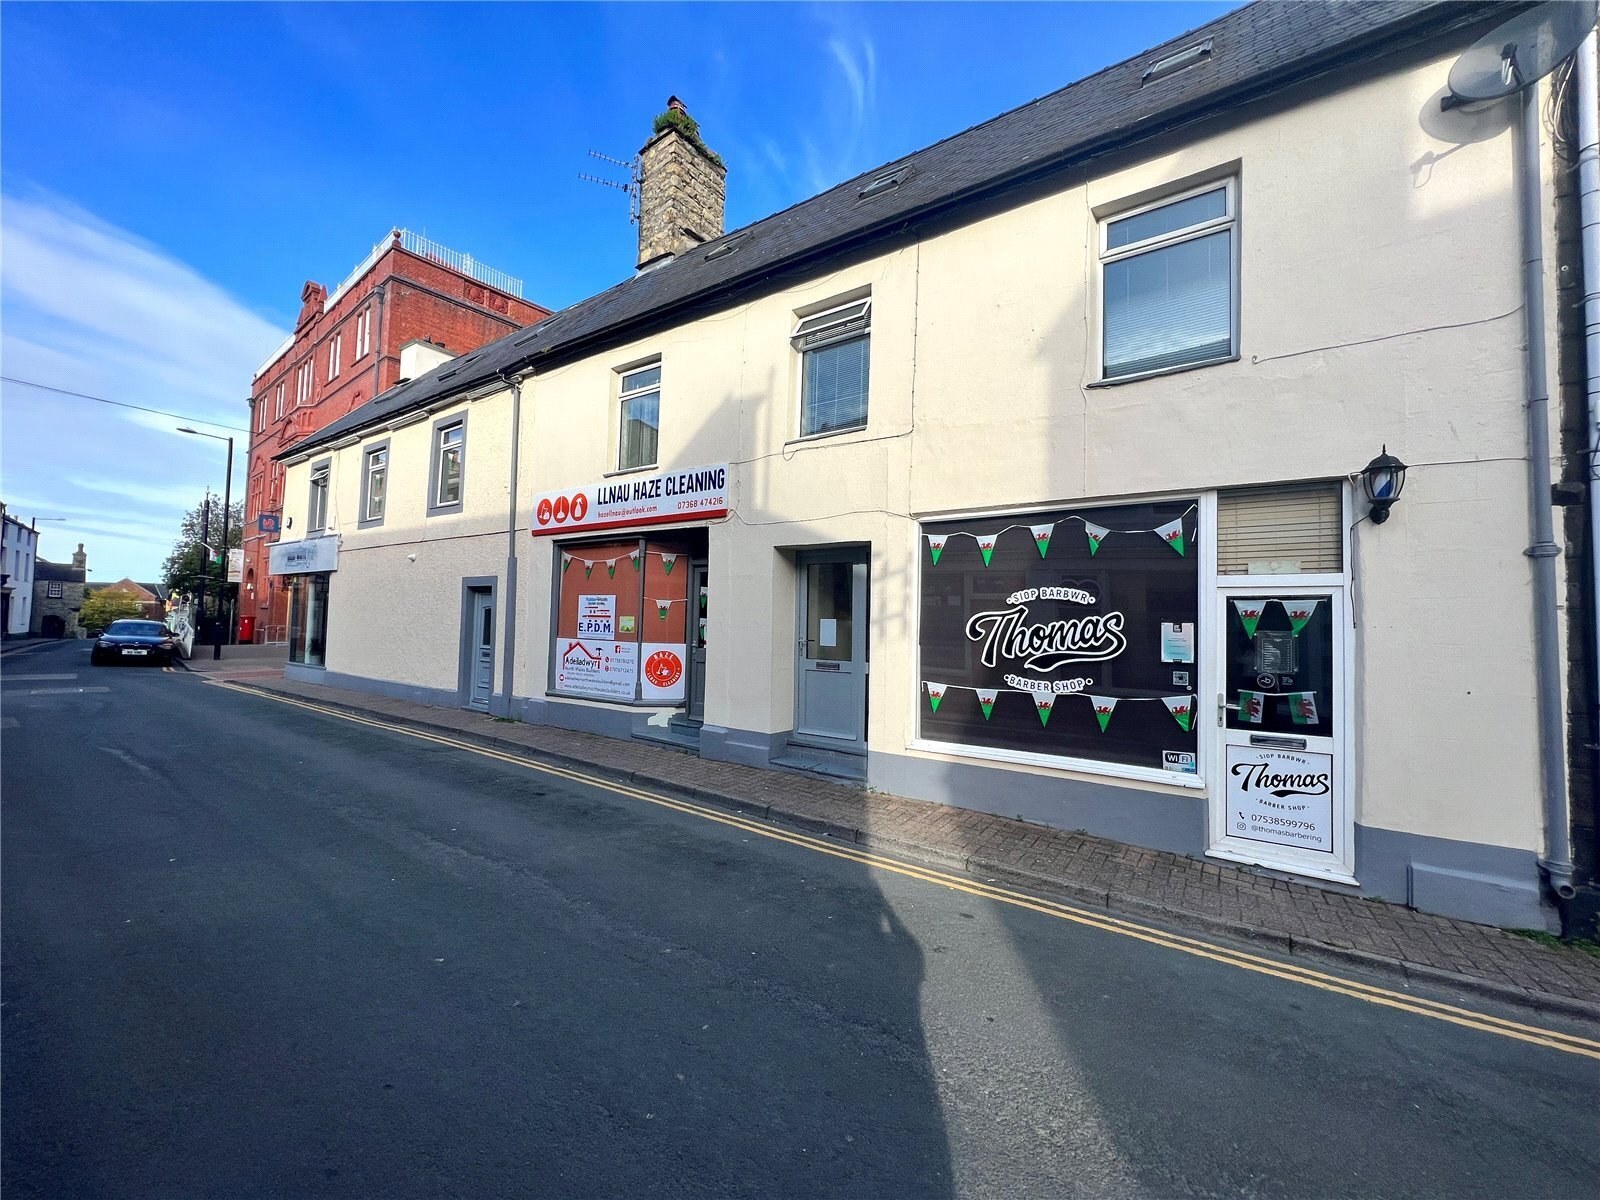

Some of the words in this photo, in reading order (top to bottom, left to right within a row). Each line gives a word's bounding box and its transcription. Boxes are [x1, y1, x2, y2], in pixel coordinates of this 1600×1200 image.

[597, 483, 631, 505] LLNAU
[633, 479, 662, 501] HAZE
[665, 468, 725, 497] CLEANING
[677, 500, 698, 510] 07368
[699, 496, 723, 507] 474216
[1012, 589, 1038, 603] SIOP
[1041, 588, 1087, 604] BARBWR
[578, 622, 614, 634] E.P.D.M.
[965, 604, 1127, 672] Thomas
[1008, 675, 1051, 692] BARBER
[1053, 678, 1084, 693] SHOP
[1277, 754, 1307, 764] BARBWR
[1231, 762, 1330, 798] Thomas
[1259, 799, 1285, 810] BARBER
[1251, 813, 1316, 831] 07538599796
[1251, 824, 1322, 843] @thomasbarbering
